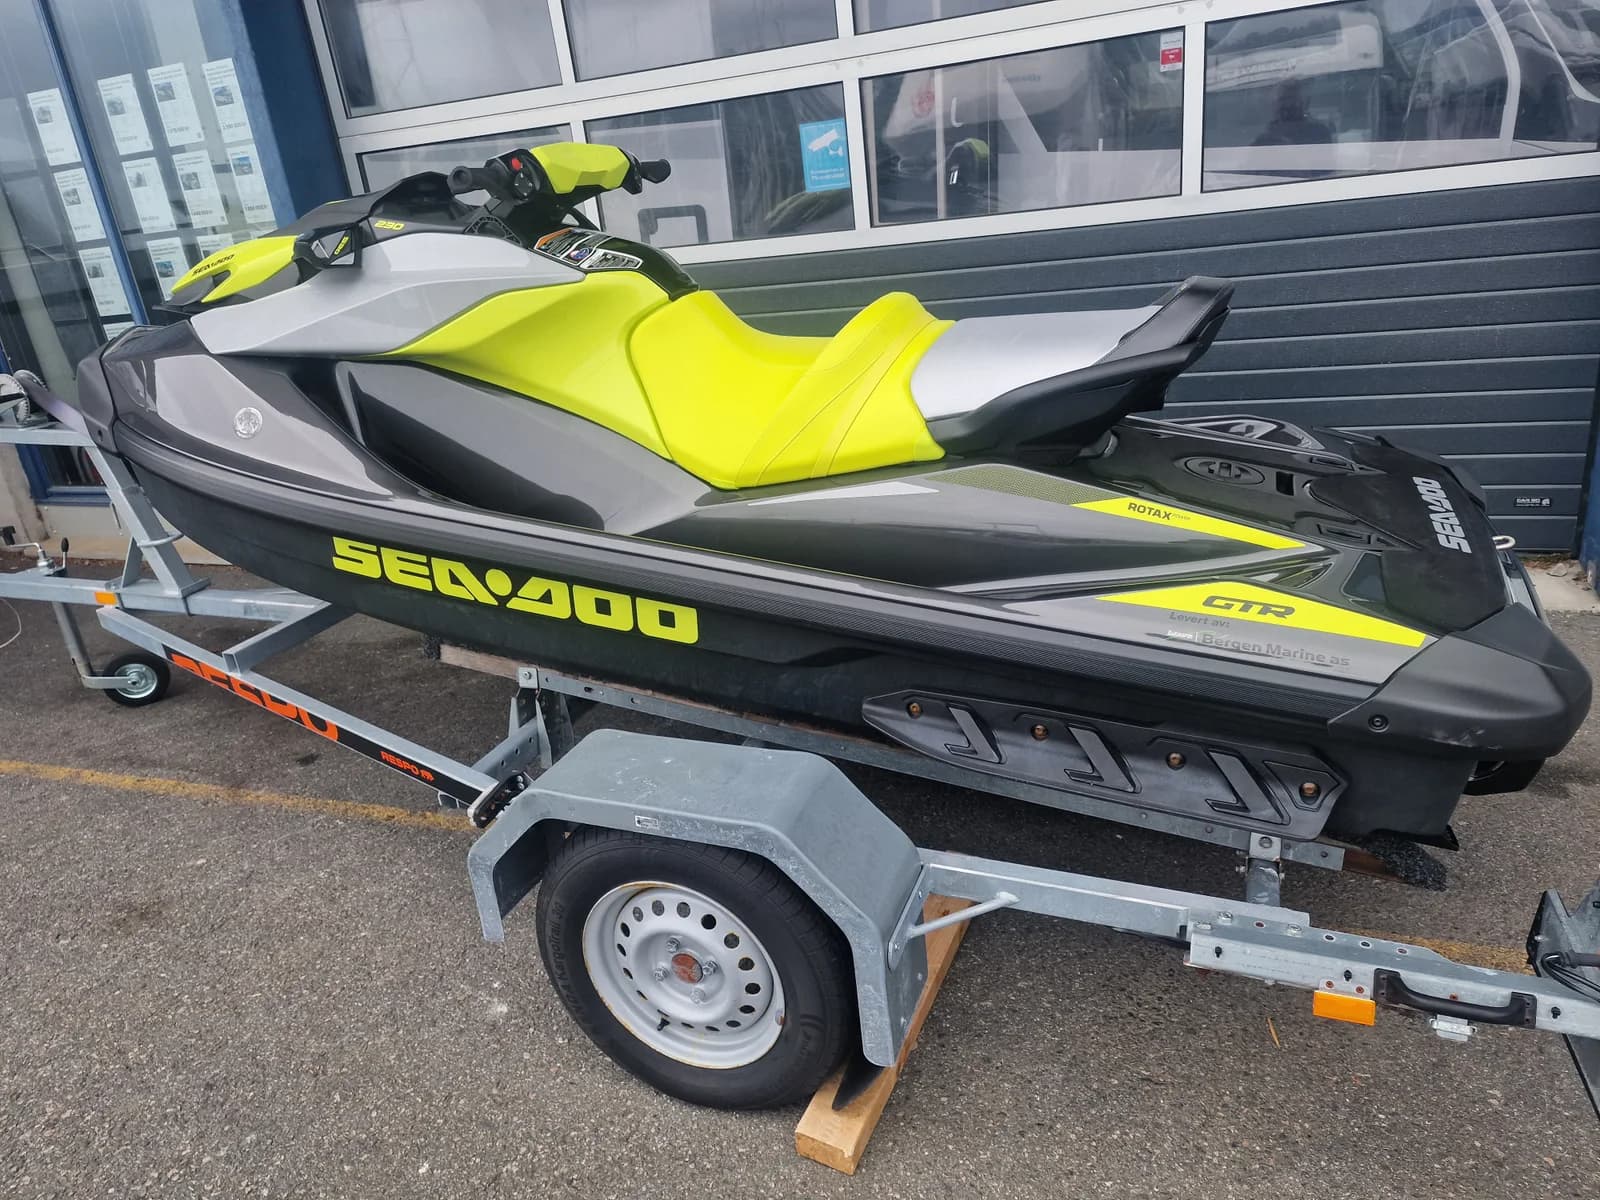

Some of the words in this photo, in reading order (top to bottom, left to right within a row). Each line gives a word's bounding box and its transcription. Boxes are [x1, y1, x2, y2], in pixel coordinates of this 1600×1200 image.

[374, 219, 406, 231] 230
[1127, 502, 1172, 521] ROTAX
[1202, 595, 1296, 619] GTR
[1168, 611, 1209, 625] Levert
[1201, 632, 1263, 655] Bergen
[1265, 642, 1326, 664] Marine
[1329, 654, 1351, 667] as
[380, 750, 420, 776] RESPO
